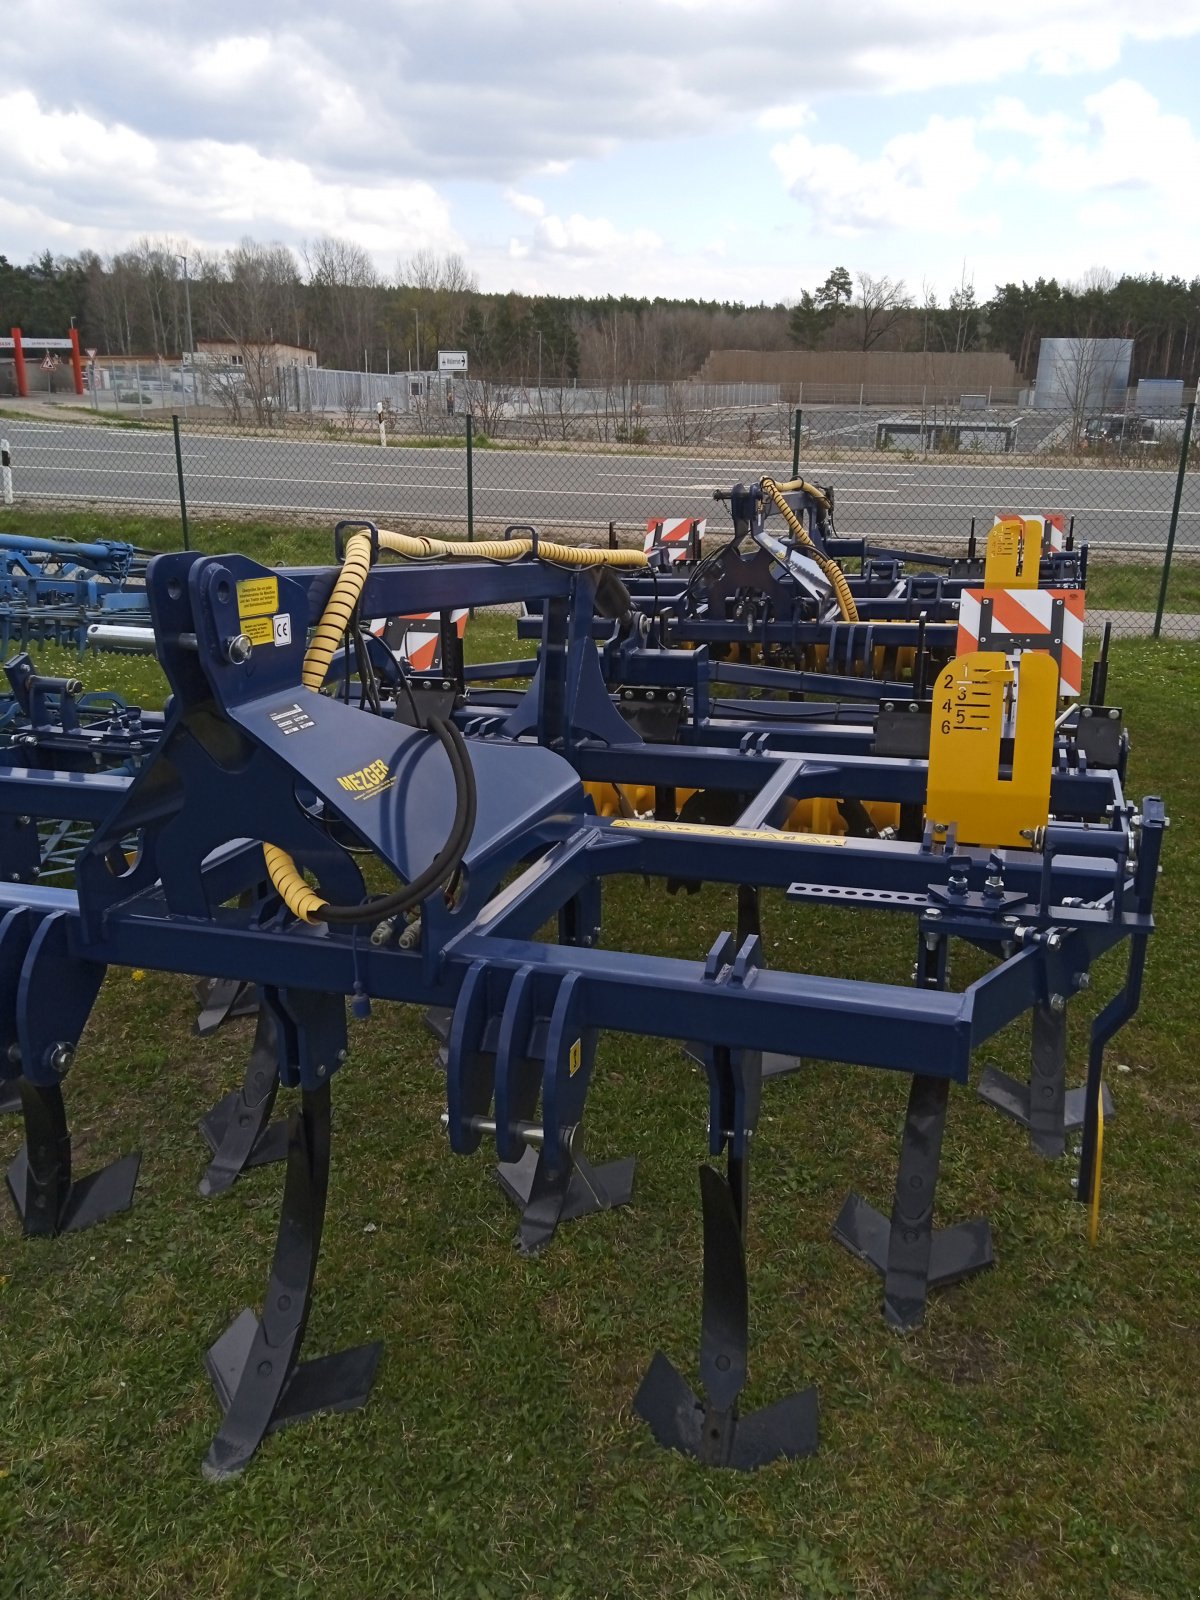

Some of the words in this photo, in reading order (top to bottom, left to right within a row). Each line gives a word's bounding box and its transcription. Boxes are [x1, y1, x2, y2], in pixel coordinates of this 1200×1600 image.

[963, 662, 968, 678] 1
[944, 674, 953, 689] 2
[957, 686, 967, 701] 3
[942, 699, 952, 713] 4
[956, 709, 966, 724] 5
[941, 720, 951, 735] 6
[336, 759, 389, 791] MEZGER
